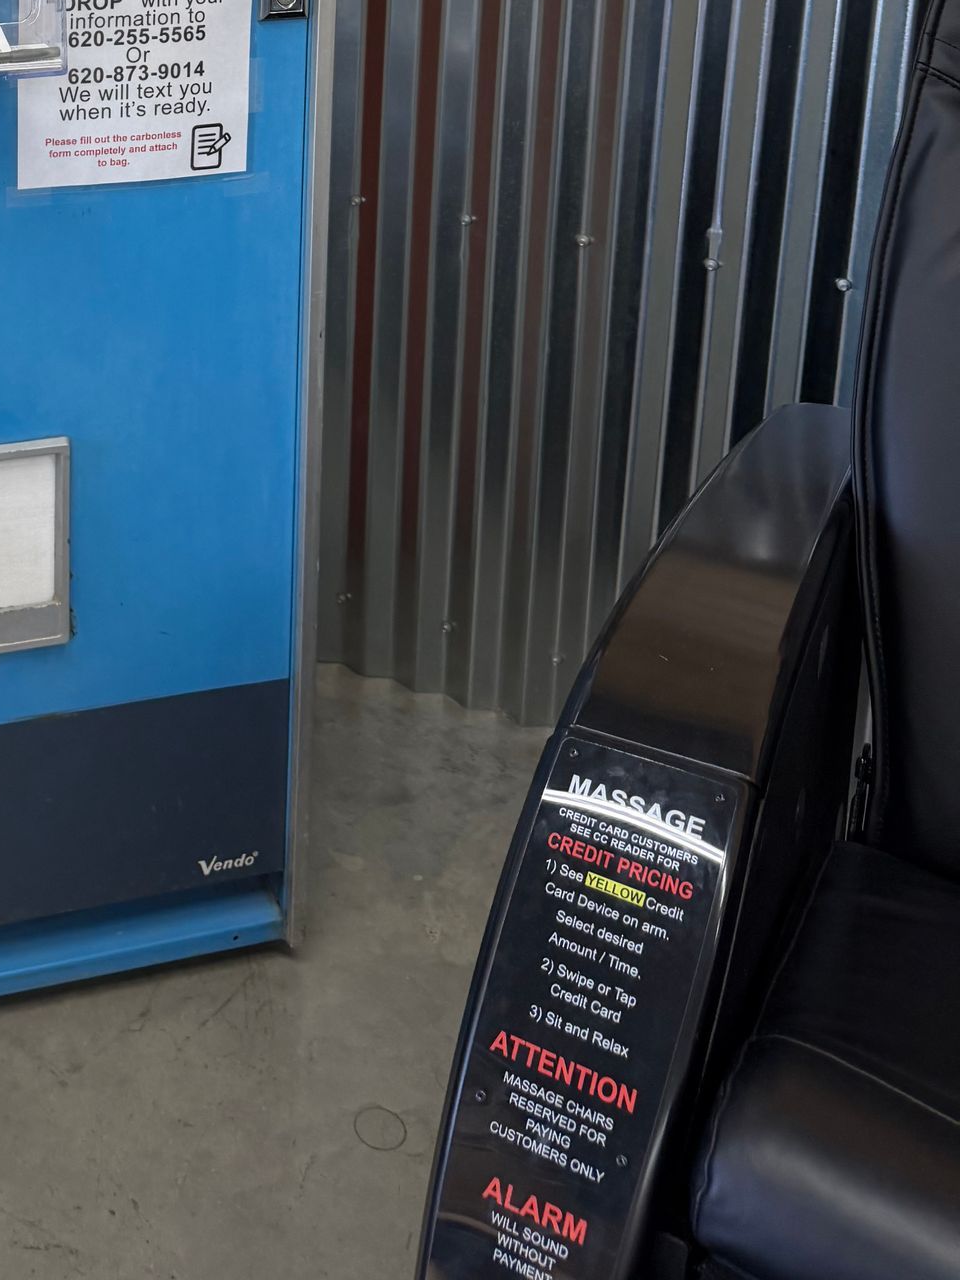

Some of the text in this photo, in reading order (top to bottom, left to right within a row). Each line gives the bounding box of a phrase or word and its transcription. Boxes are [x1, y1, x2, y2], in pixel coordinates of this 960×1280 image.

[68, 25, 206, 48] 620-255-5565
[70, 9, 206, 30] information to
[68, 61, 205, 84] 620-873-9014
[126, 46, 150, 63] Or
[58, 81, 212, 103] We will text you
[59, 97, 210, 121] when it’s ready.
[45, 130, 182, 147] Please fill out the carbonless
[48, 142, 178, 159] form completely and attach
[97, 158, 130, 168] to bag.
[567, 774, 706, 841] MASSAGE
[558, 807, 699, 865] CREDIT CARD CUSTOMERS
[570, 823, 680, 871] SEE CC READER FOR
[545, 858, 685, 921] 1) See YELLOW Credit
[547, 832, 694, 900] CREDIT PRICING
[545, 882, 669, 941] Card Device on arm.
[555, 910, 644, 955] Select desired
[548, 931, 641, 979] Amount / Time.
[540, 957, 637, 1008] 2) Swipe or Tap
[550, 983, 622, 1023] Credit Card
[529, 1004, 630, 1058] 3) Sit and Relax
[490, 1030, 638, 1114] ATTENTION
[503, 1071, 615, 1131] MASSAGE CHAIRS
[509, 1092, 607, 1147] RESERVED FOR
[489, 1120, 605, 1184] CUSTOMERS ONLY
[525, 1118, 571, 1150] PAYING
[482, 1176, 588, 1246] ALARM
[491, 1210, 569, 1260] WILL SOUND
[497, 1231, 557, 1271] WITHOUT
